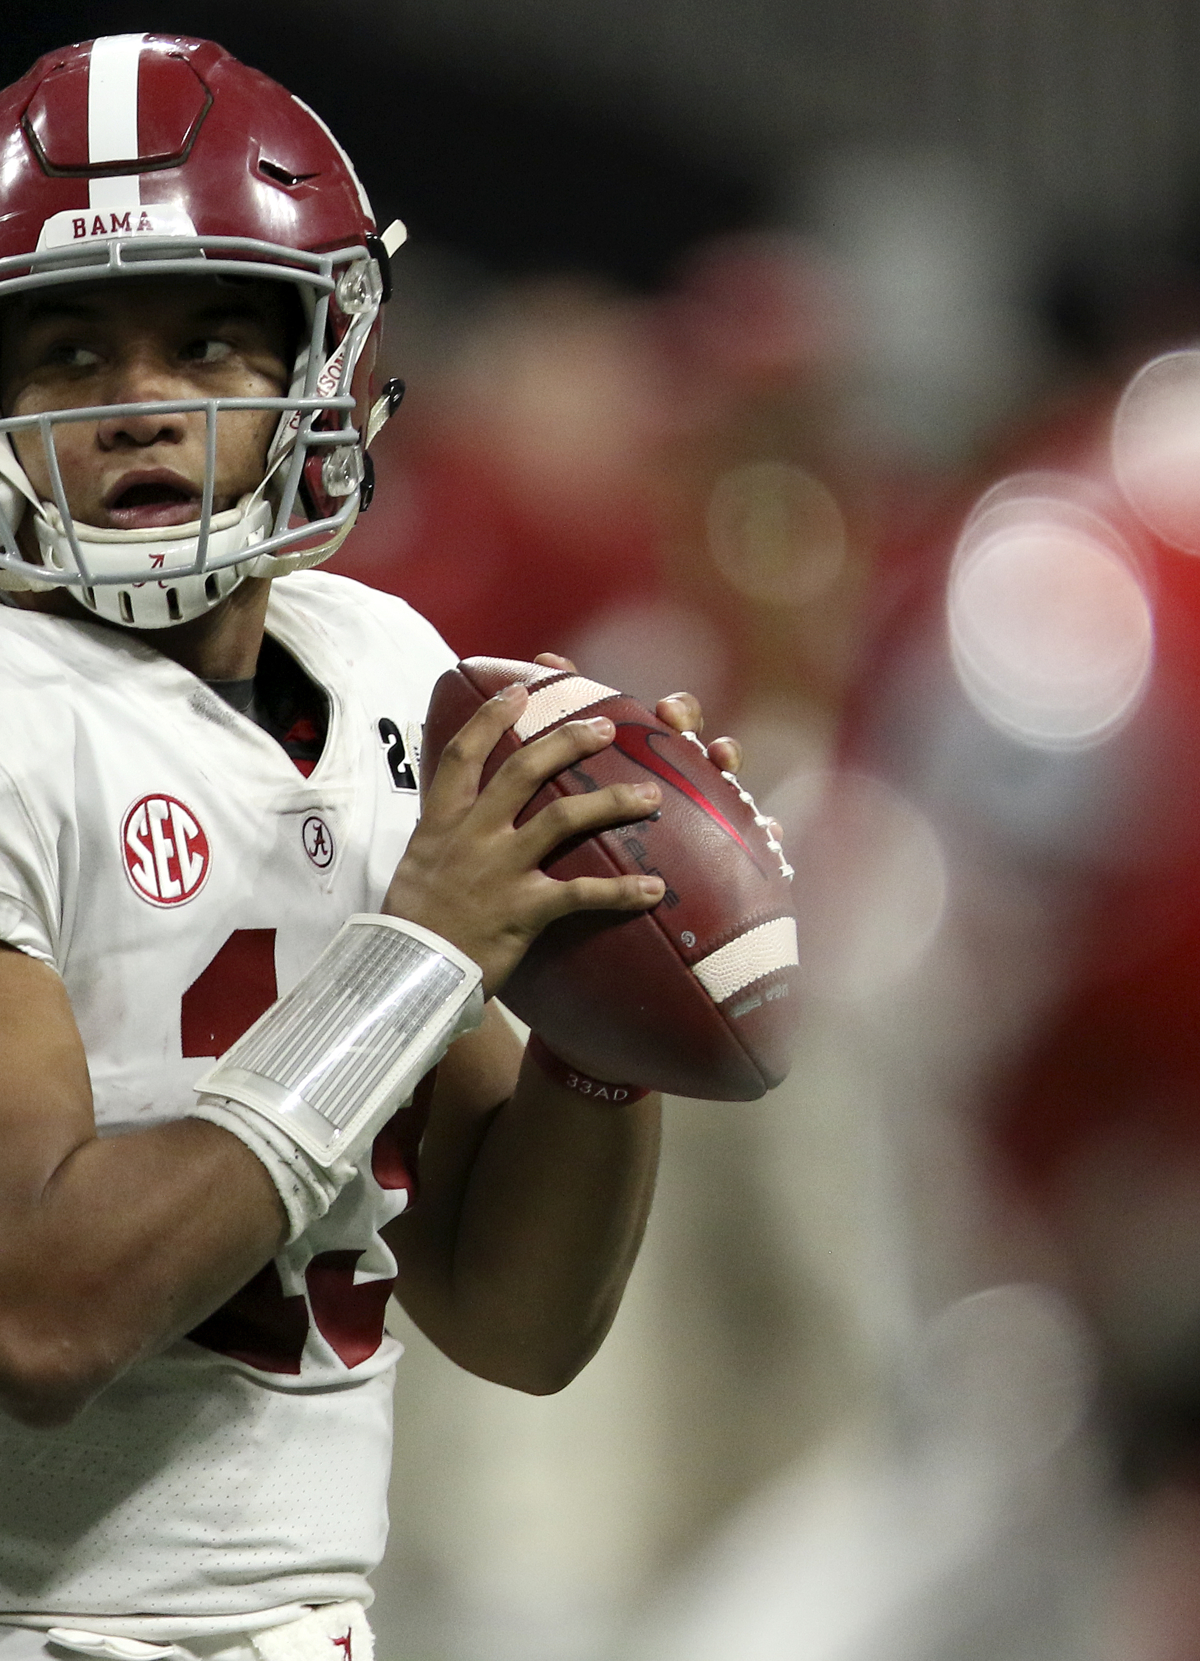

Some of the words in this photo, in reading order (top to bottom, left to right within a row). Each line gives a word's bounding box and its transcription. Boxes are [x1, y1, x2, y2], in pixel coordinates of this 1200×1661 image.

[72, 211, 154, 239] BAMA
[126, 799, 205, 899] SEC
[309, 823, 328, 857] A
[566, 1073, 628, 1101] 33AD
